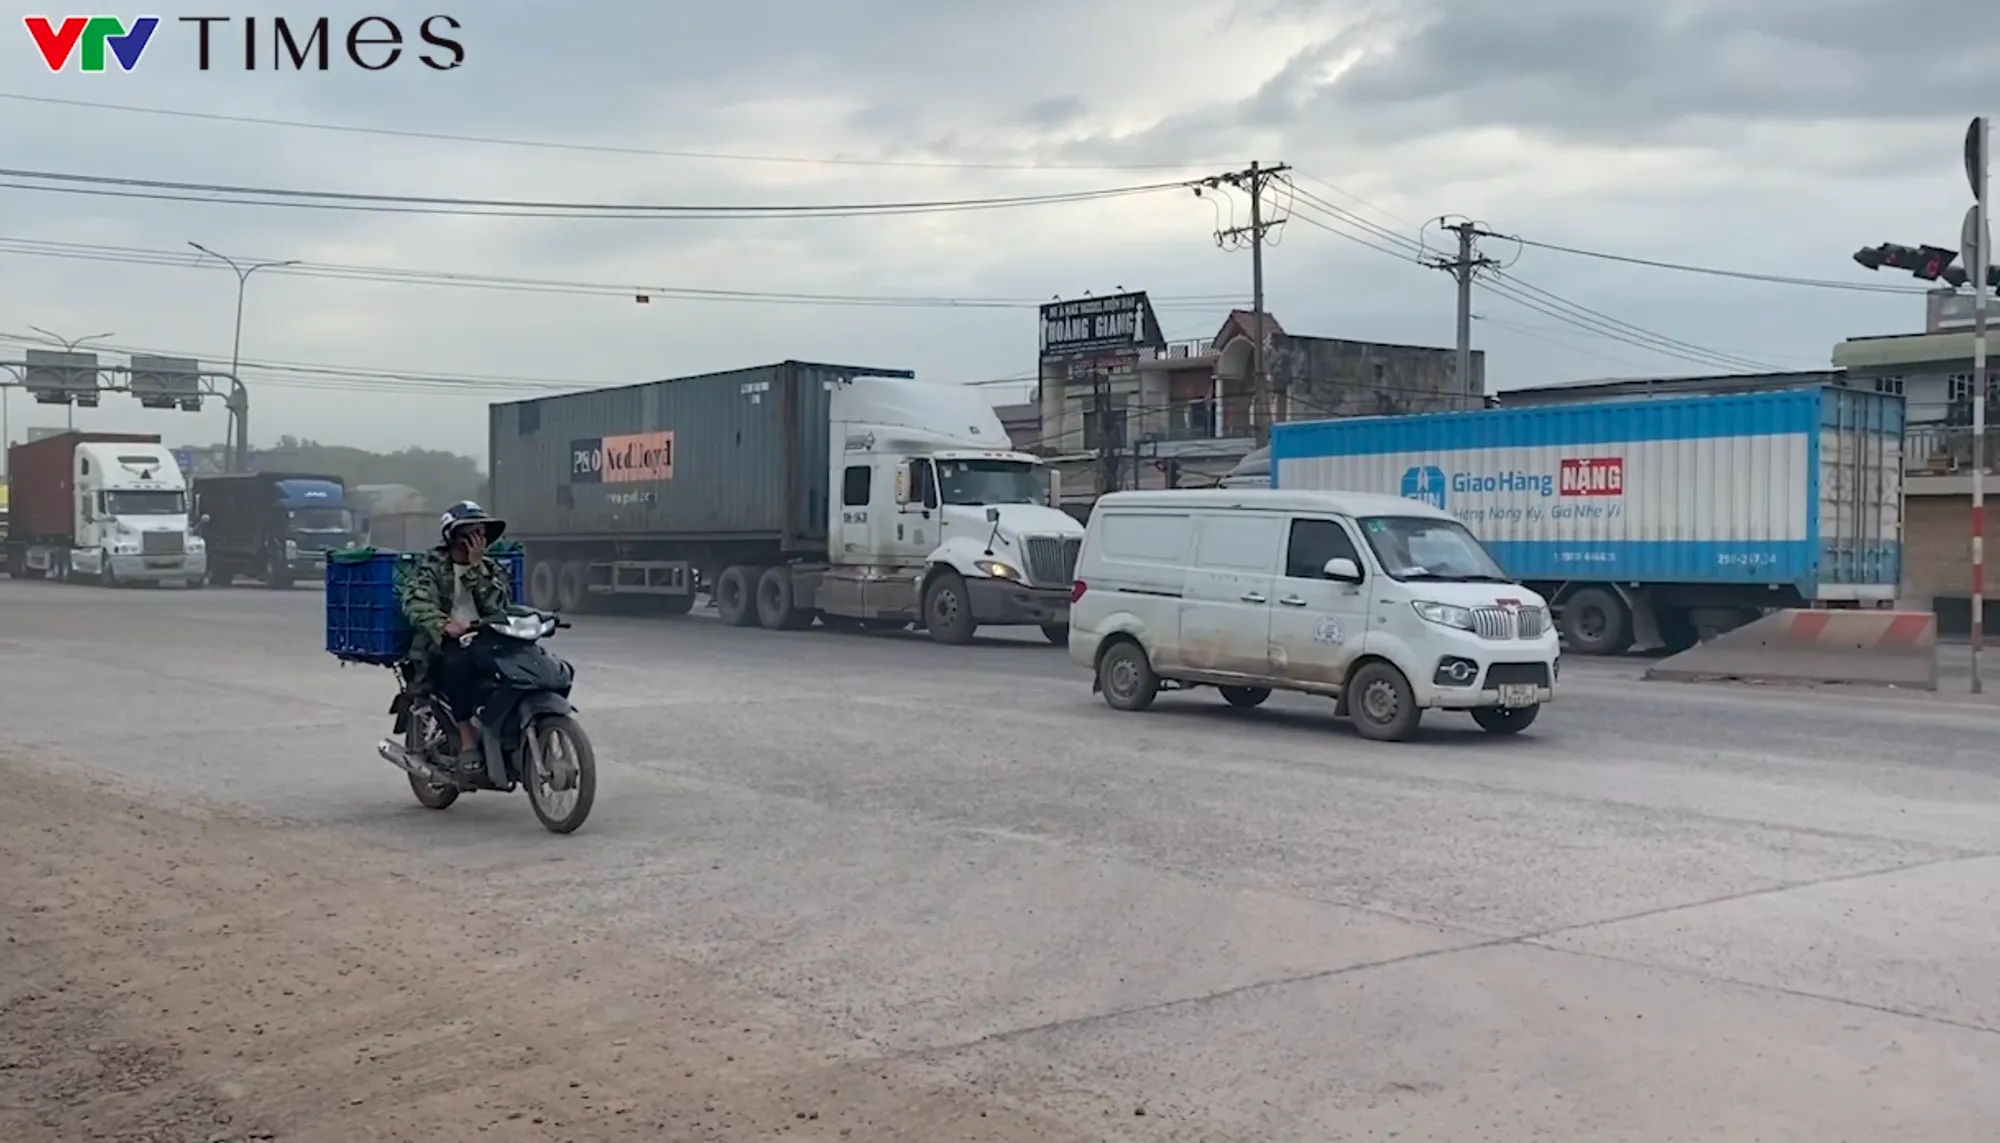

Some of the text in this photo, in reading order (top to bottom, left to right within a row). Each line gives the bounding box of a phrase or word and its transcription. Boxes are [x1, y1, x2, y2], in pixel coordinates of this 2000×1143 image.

[1095, 312, 1134, 338] GIANG
[1452, 471, 1553, 497] Giao Hàng
[1562, 460, 1621, 494] NẶNG
